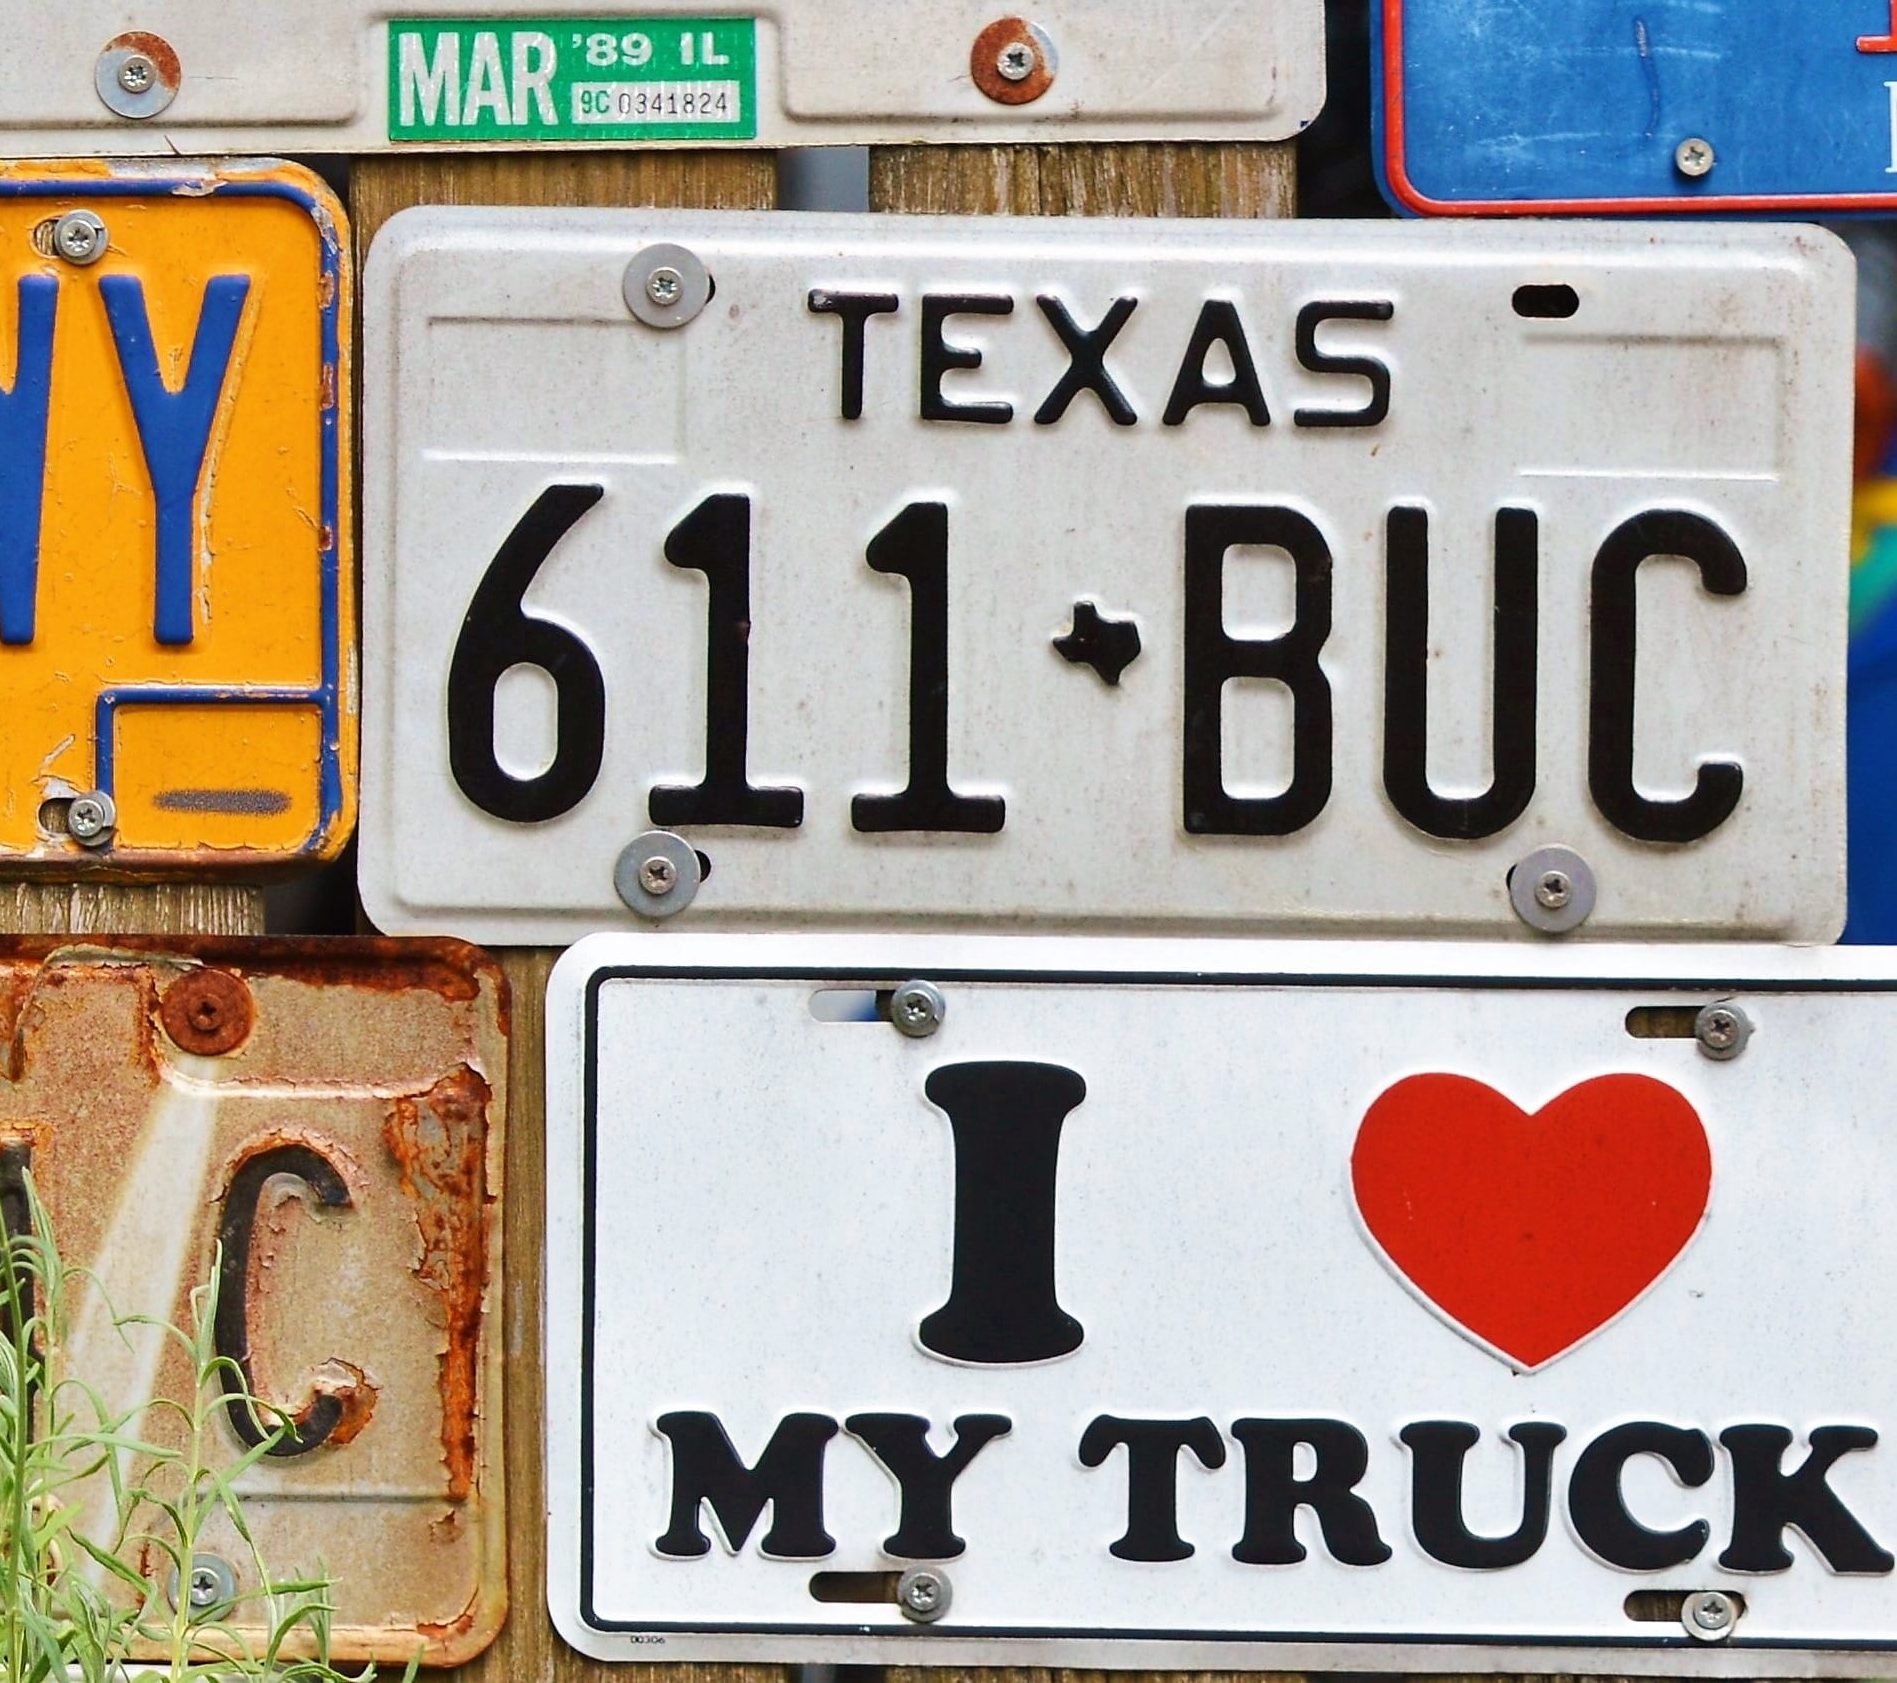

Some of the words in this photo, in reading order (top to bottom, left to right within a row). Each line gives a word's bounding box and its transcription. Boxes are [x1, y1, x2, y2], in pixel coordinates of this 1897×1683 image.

[398, 31, 558, 126] MAR
[572, 32, 653, 66] '89
[806, 288, 1396, 428] TEXAS
[445, 482, 1006, 834] 611
[1182, 501, 1749, 844] BUC
[918, 1060, 1087, 1365] I
[653, 1410, 1012, 1560] MY
[1077, 1414, 1897, 1578] TRUCK
